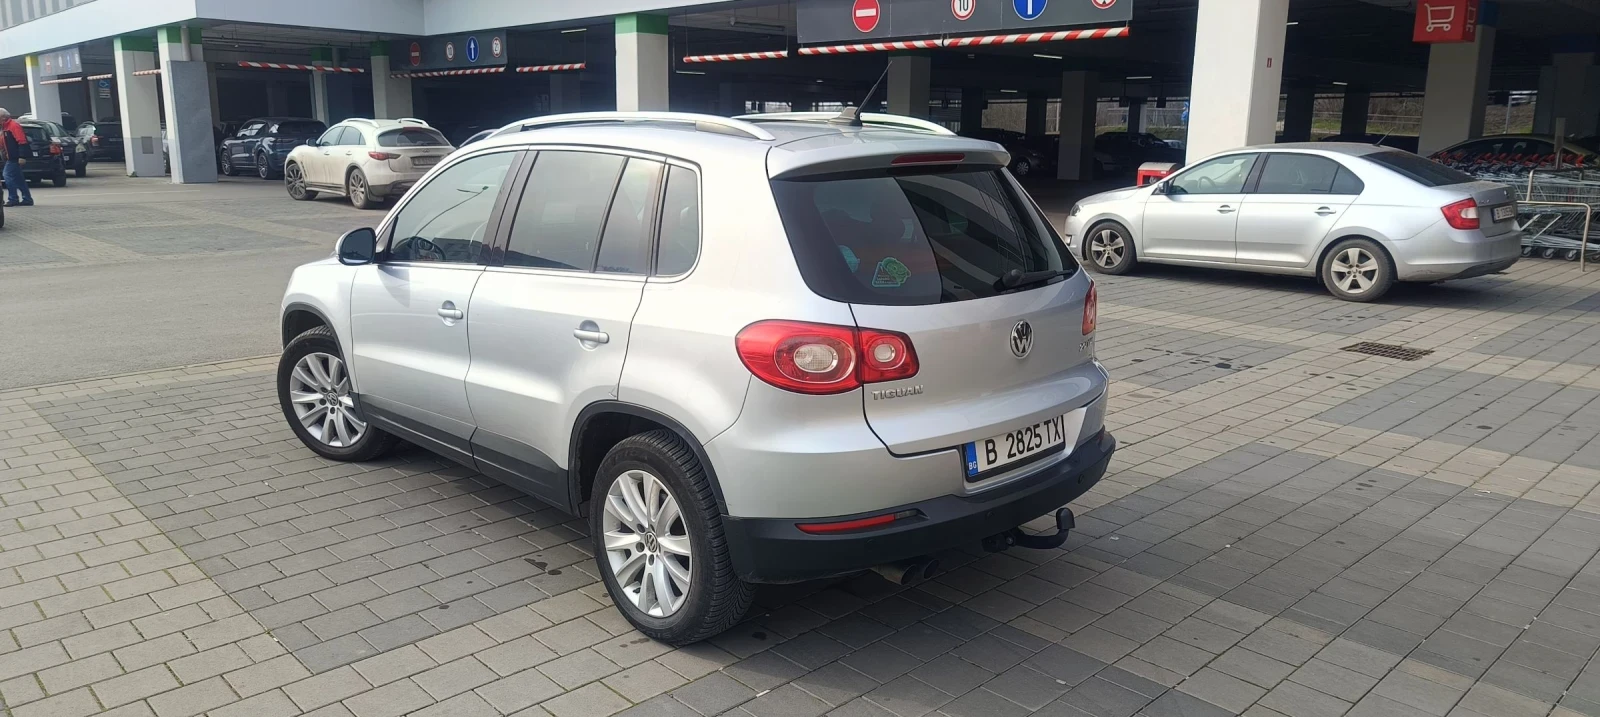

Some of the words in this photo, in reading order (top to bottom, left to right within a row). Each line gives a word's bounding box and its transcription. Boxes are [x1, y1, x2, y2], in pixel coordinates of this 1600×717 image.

[959, 0, 969, 12] 10
[871, 385, 924, 400] TIGUAN
[985, 439, 998, 466] B
[1006, 424, 1042, 460] 2825
[1044, 416, 1061, 444] TX
[968, 461, 978, 470] BG
